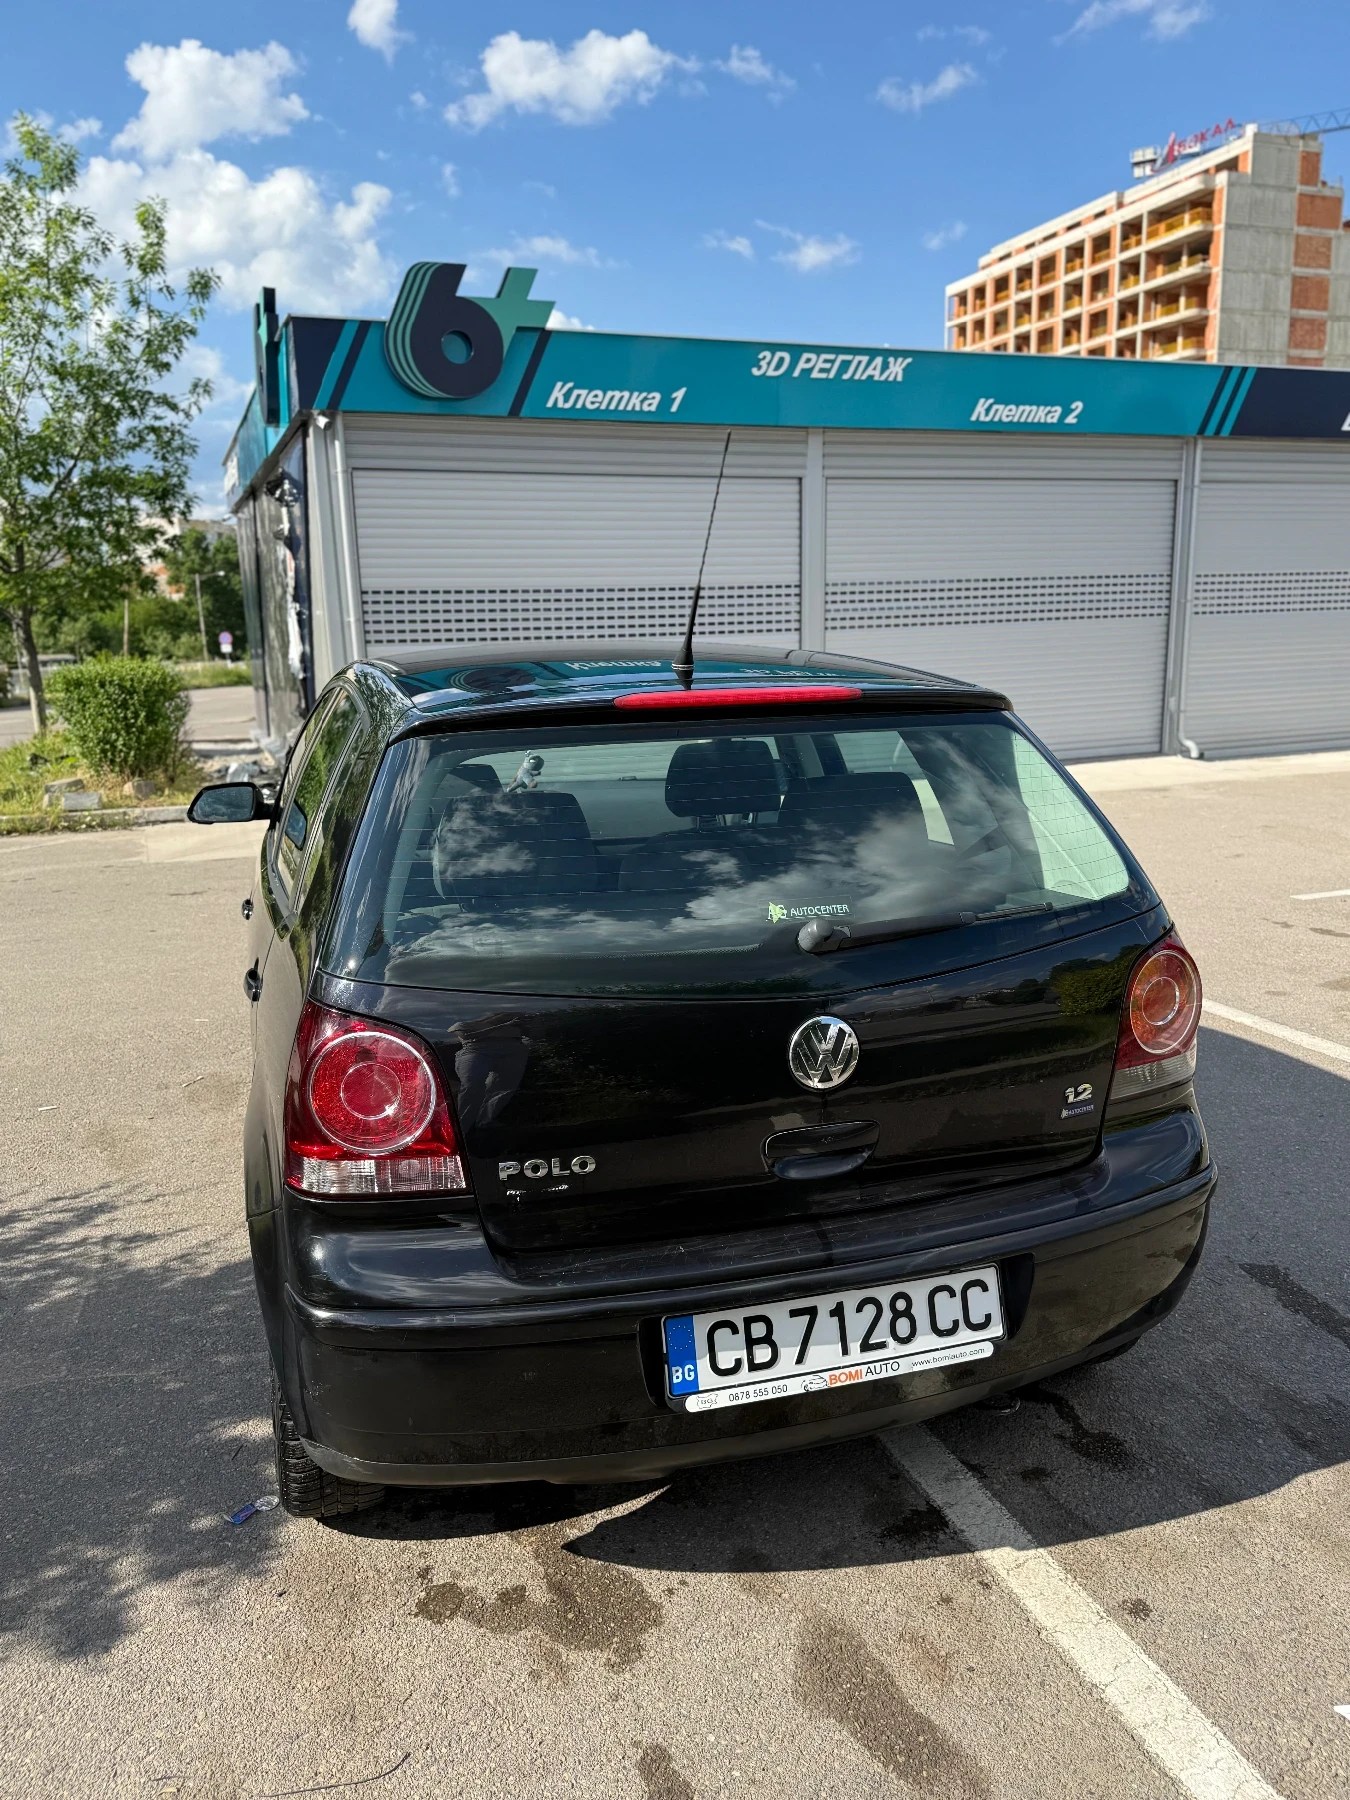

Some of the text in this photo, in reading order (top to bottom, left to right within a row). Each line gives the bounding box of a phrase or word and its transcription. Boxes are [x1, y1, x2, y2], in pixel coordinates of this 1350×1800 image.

[751, 350, 912, 381] 3D РЕГЛАЖ
[546, 381, 687, 412] Клетка 1
[970, 398, 1083, 424] Клетка 2
[790, 904, 850, 917] AUTOCENTER
[498, 1155, 597, 1181] POLO
[706, 1278, 993, 1377] CB 7128 CC
[911, 1347, 986, 1368] www.bomiauto.com
[671, 1363, 696, 1384] BG
[828, 1360, 901, 1386] BOMI AUTO
[728, 1390, 751, 1403] 0878
[753, 1387, 769, 1399] 555
[771, 1384, 788, 1395] 050
